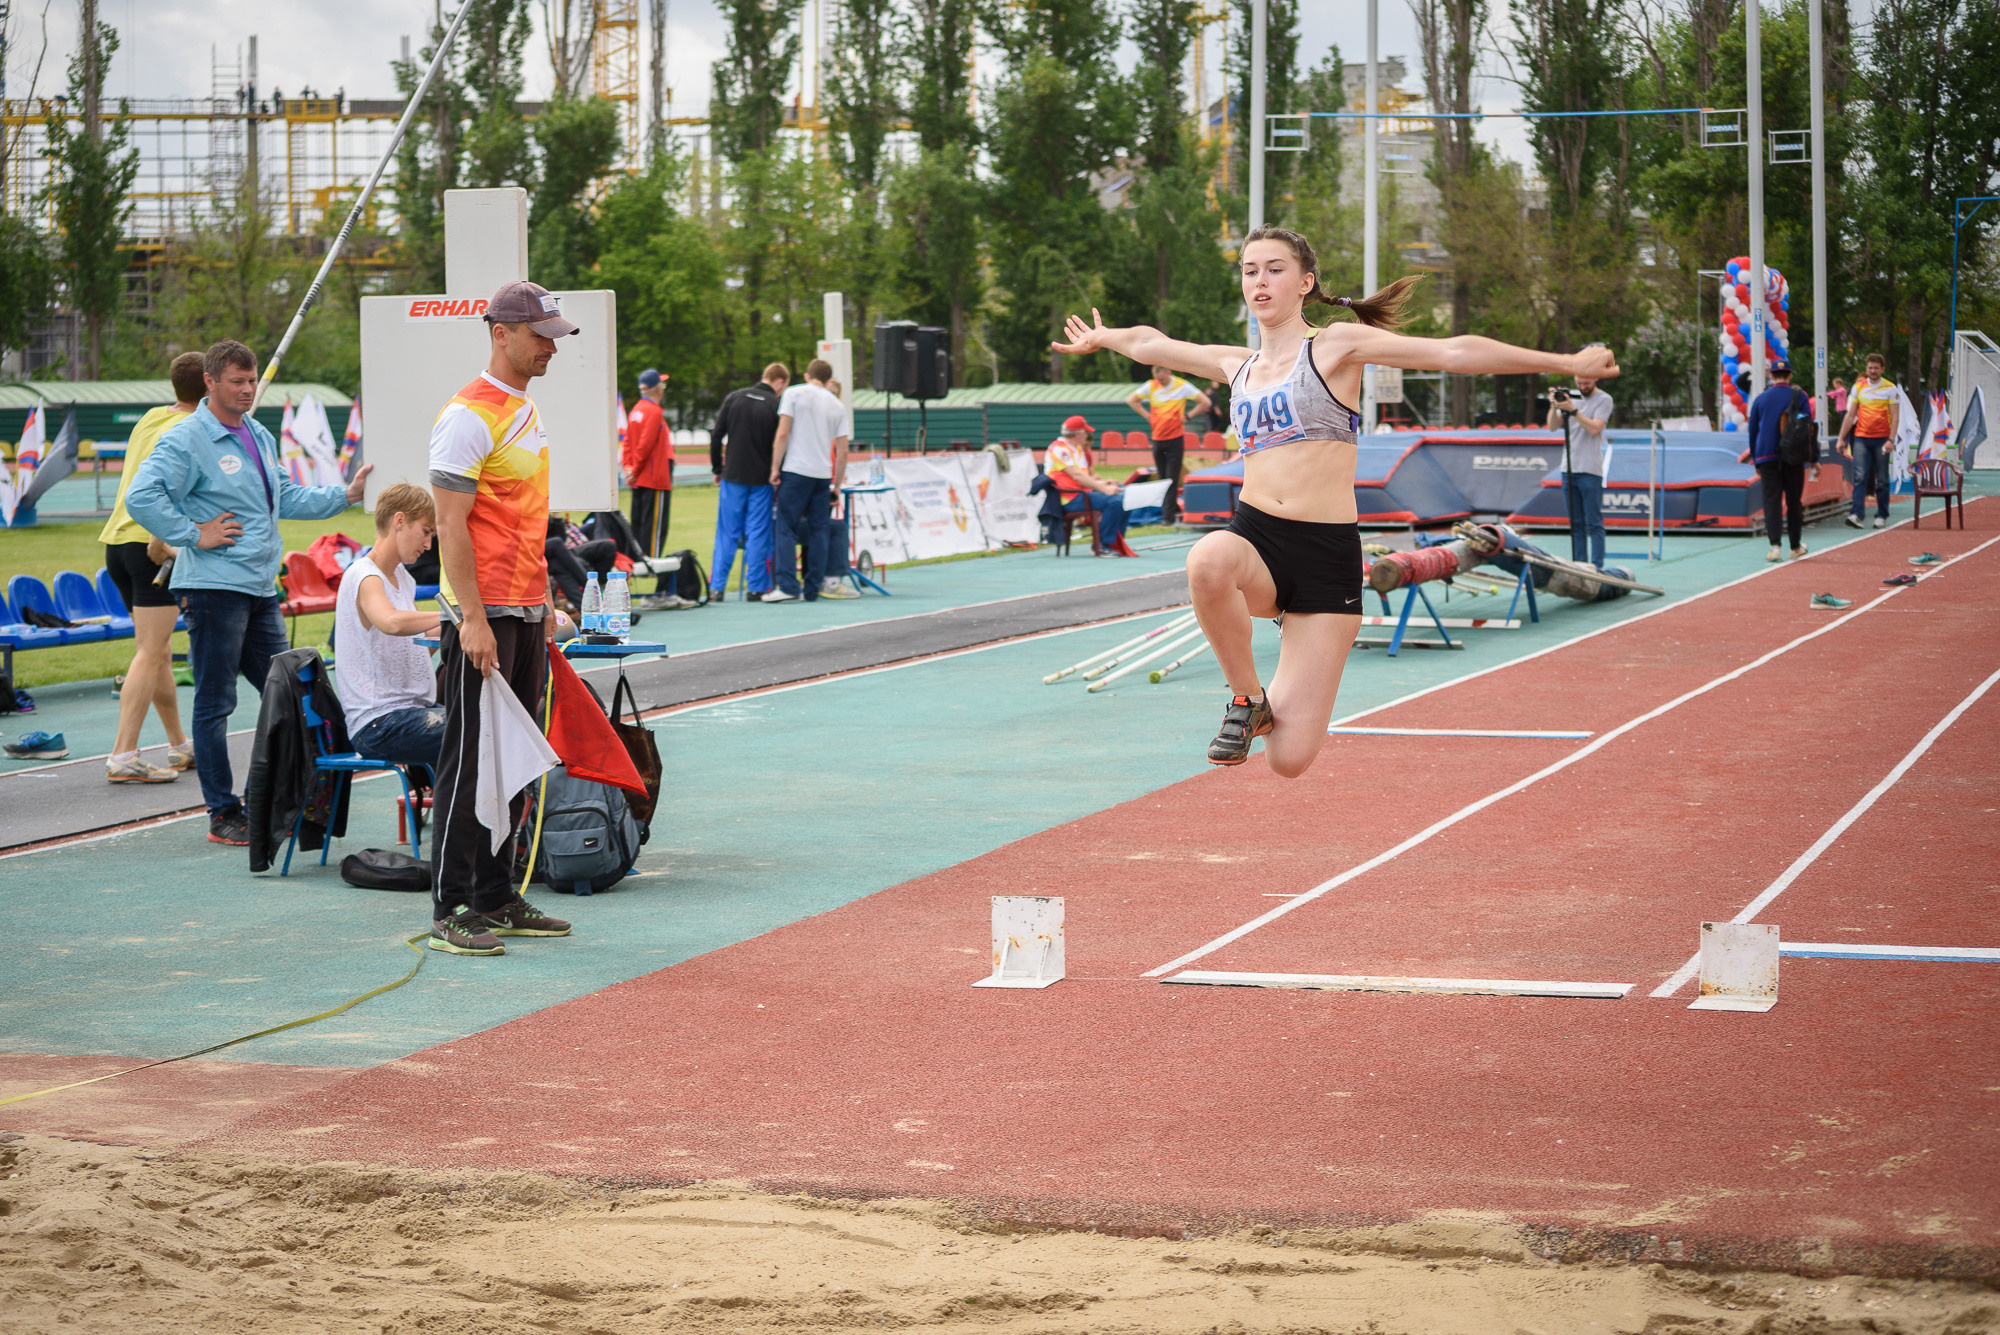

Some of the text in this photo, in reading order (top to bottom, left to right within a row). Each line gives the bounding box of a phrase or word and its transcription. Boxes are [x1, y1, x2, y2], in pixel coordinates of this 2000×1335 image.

[409, 299, 489, 317] ERHAR
[1237, 391, 1293, 439] 249
[1473, 456, 1548, 466] DIMA
[1602, 493, 1651, 506] MA
